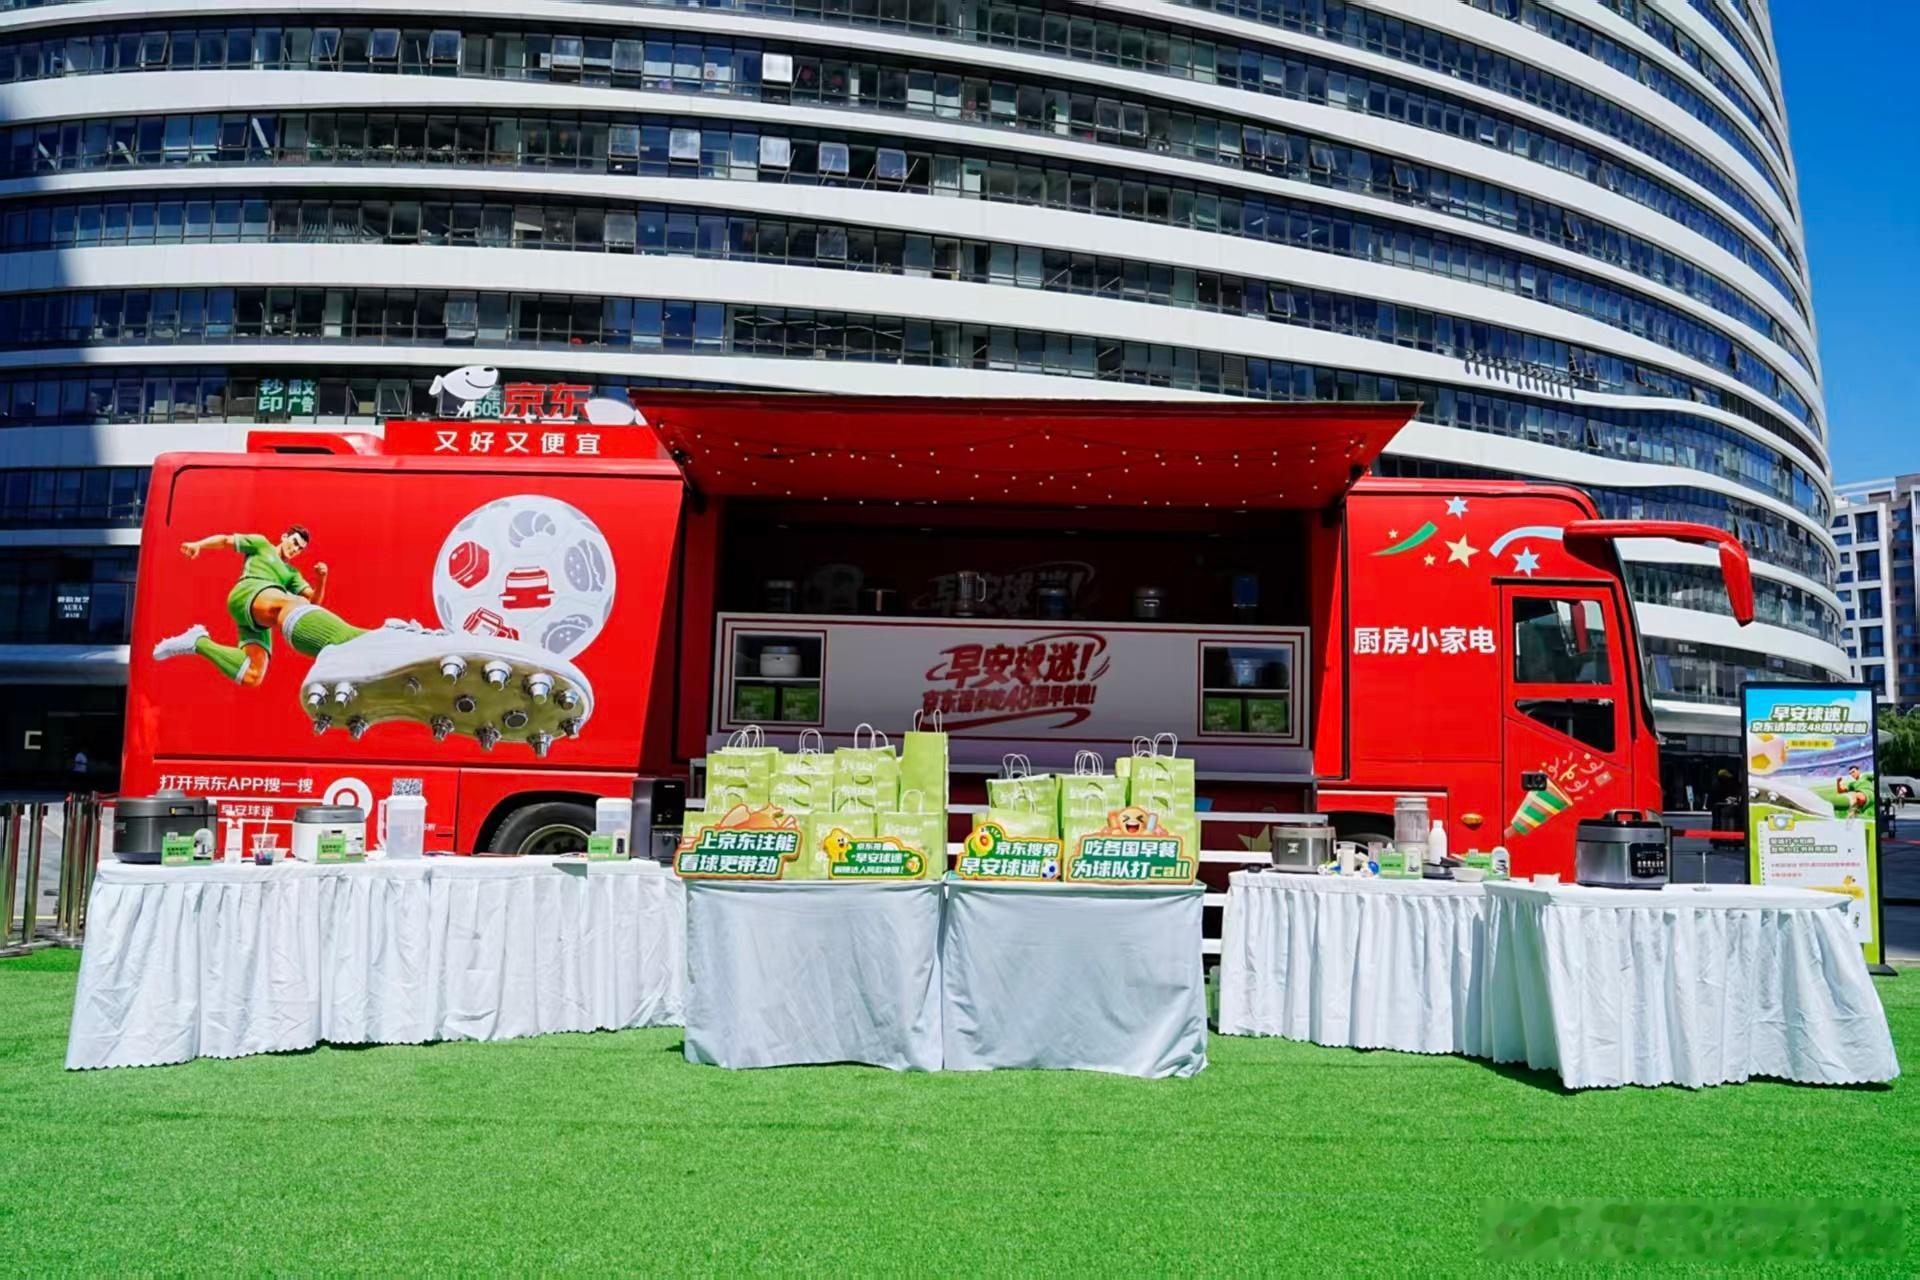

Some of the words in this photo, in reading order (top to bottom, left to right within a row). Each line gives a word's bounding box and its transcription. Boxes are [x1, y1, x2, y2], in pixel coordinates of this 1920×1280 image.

[287, 397, 315, 413] 广告
[503, 382, 591, 418] 京东
[433, 431, 601, 455] 又好又便宜
[1353, 626, 1496, 654] 厨房小家电
[945, 642, 1096, 689] 早安球迷!
[1772, 705, 1850, 721] 早安球迷!
[159, 774, 313, 793] 打开京东APP搜一搜
[698, 831, 799, 852] 上京东注能
[995, 842, 1059, 855] 京东搜索
[1084, 839, 1178, 858] 吃各国早餐
[679, 854, 779, 874] 看球更带劲
[959, 857, 1041, 878] 早安球迷
[1072, 860, 1192, 878] 为球队打call
